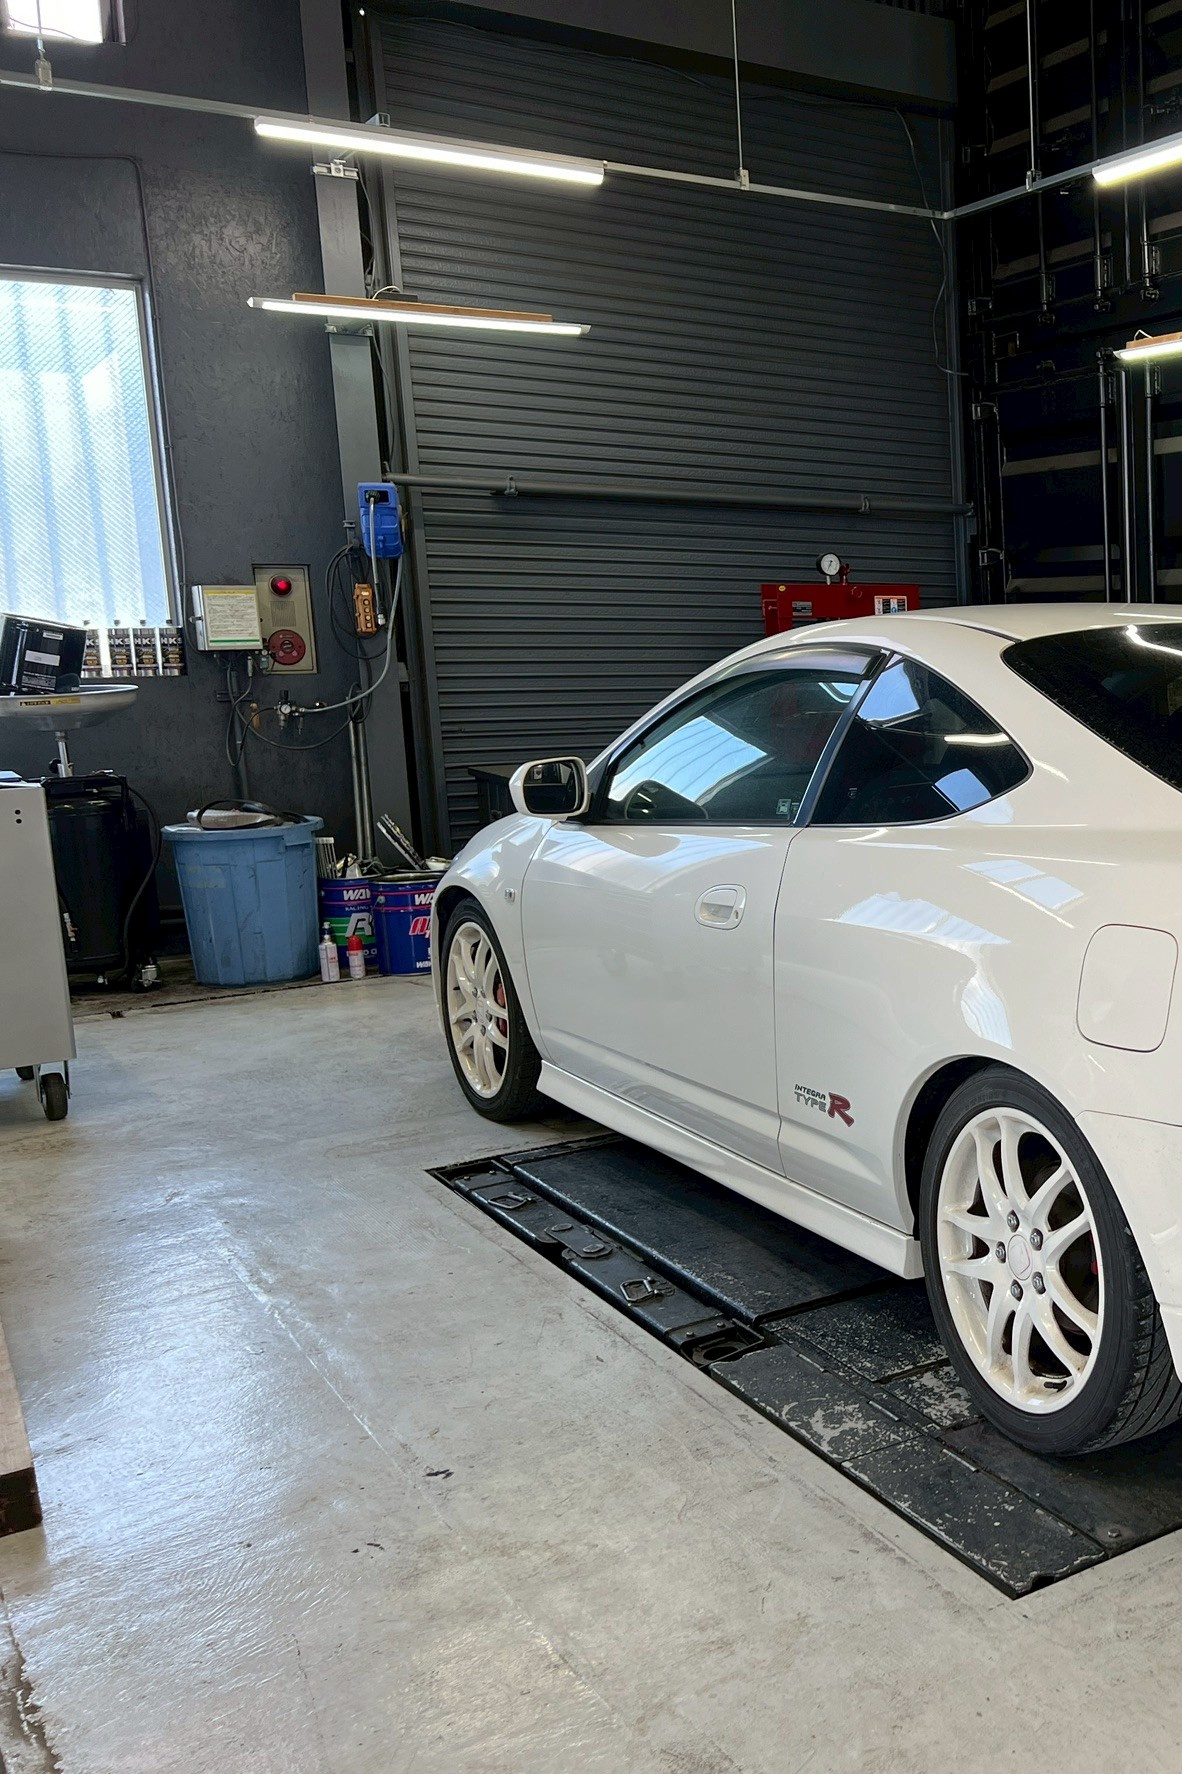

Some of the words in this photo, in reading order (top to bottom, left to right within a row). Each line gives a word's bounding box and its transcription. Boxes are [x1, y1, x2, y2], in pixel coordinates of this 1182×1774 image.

[794, 1083, 827, 1101] INTEGRA
[794, 1091, 827, 1113] TYPE
[827, 1091, 855, 1128] R
